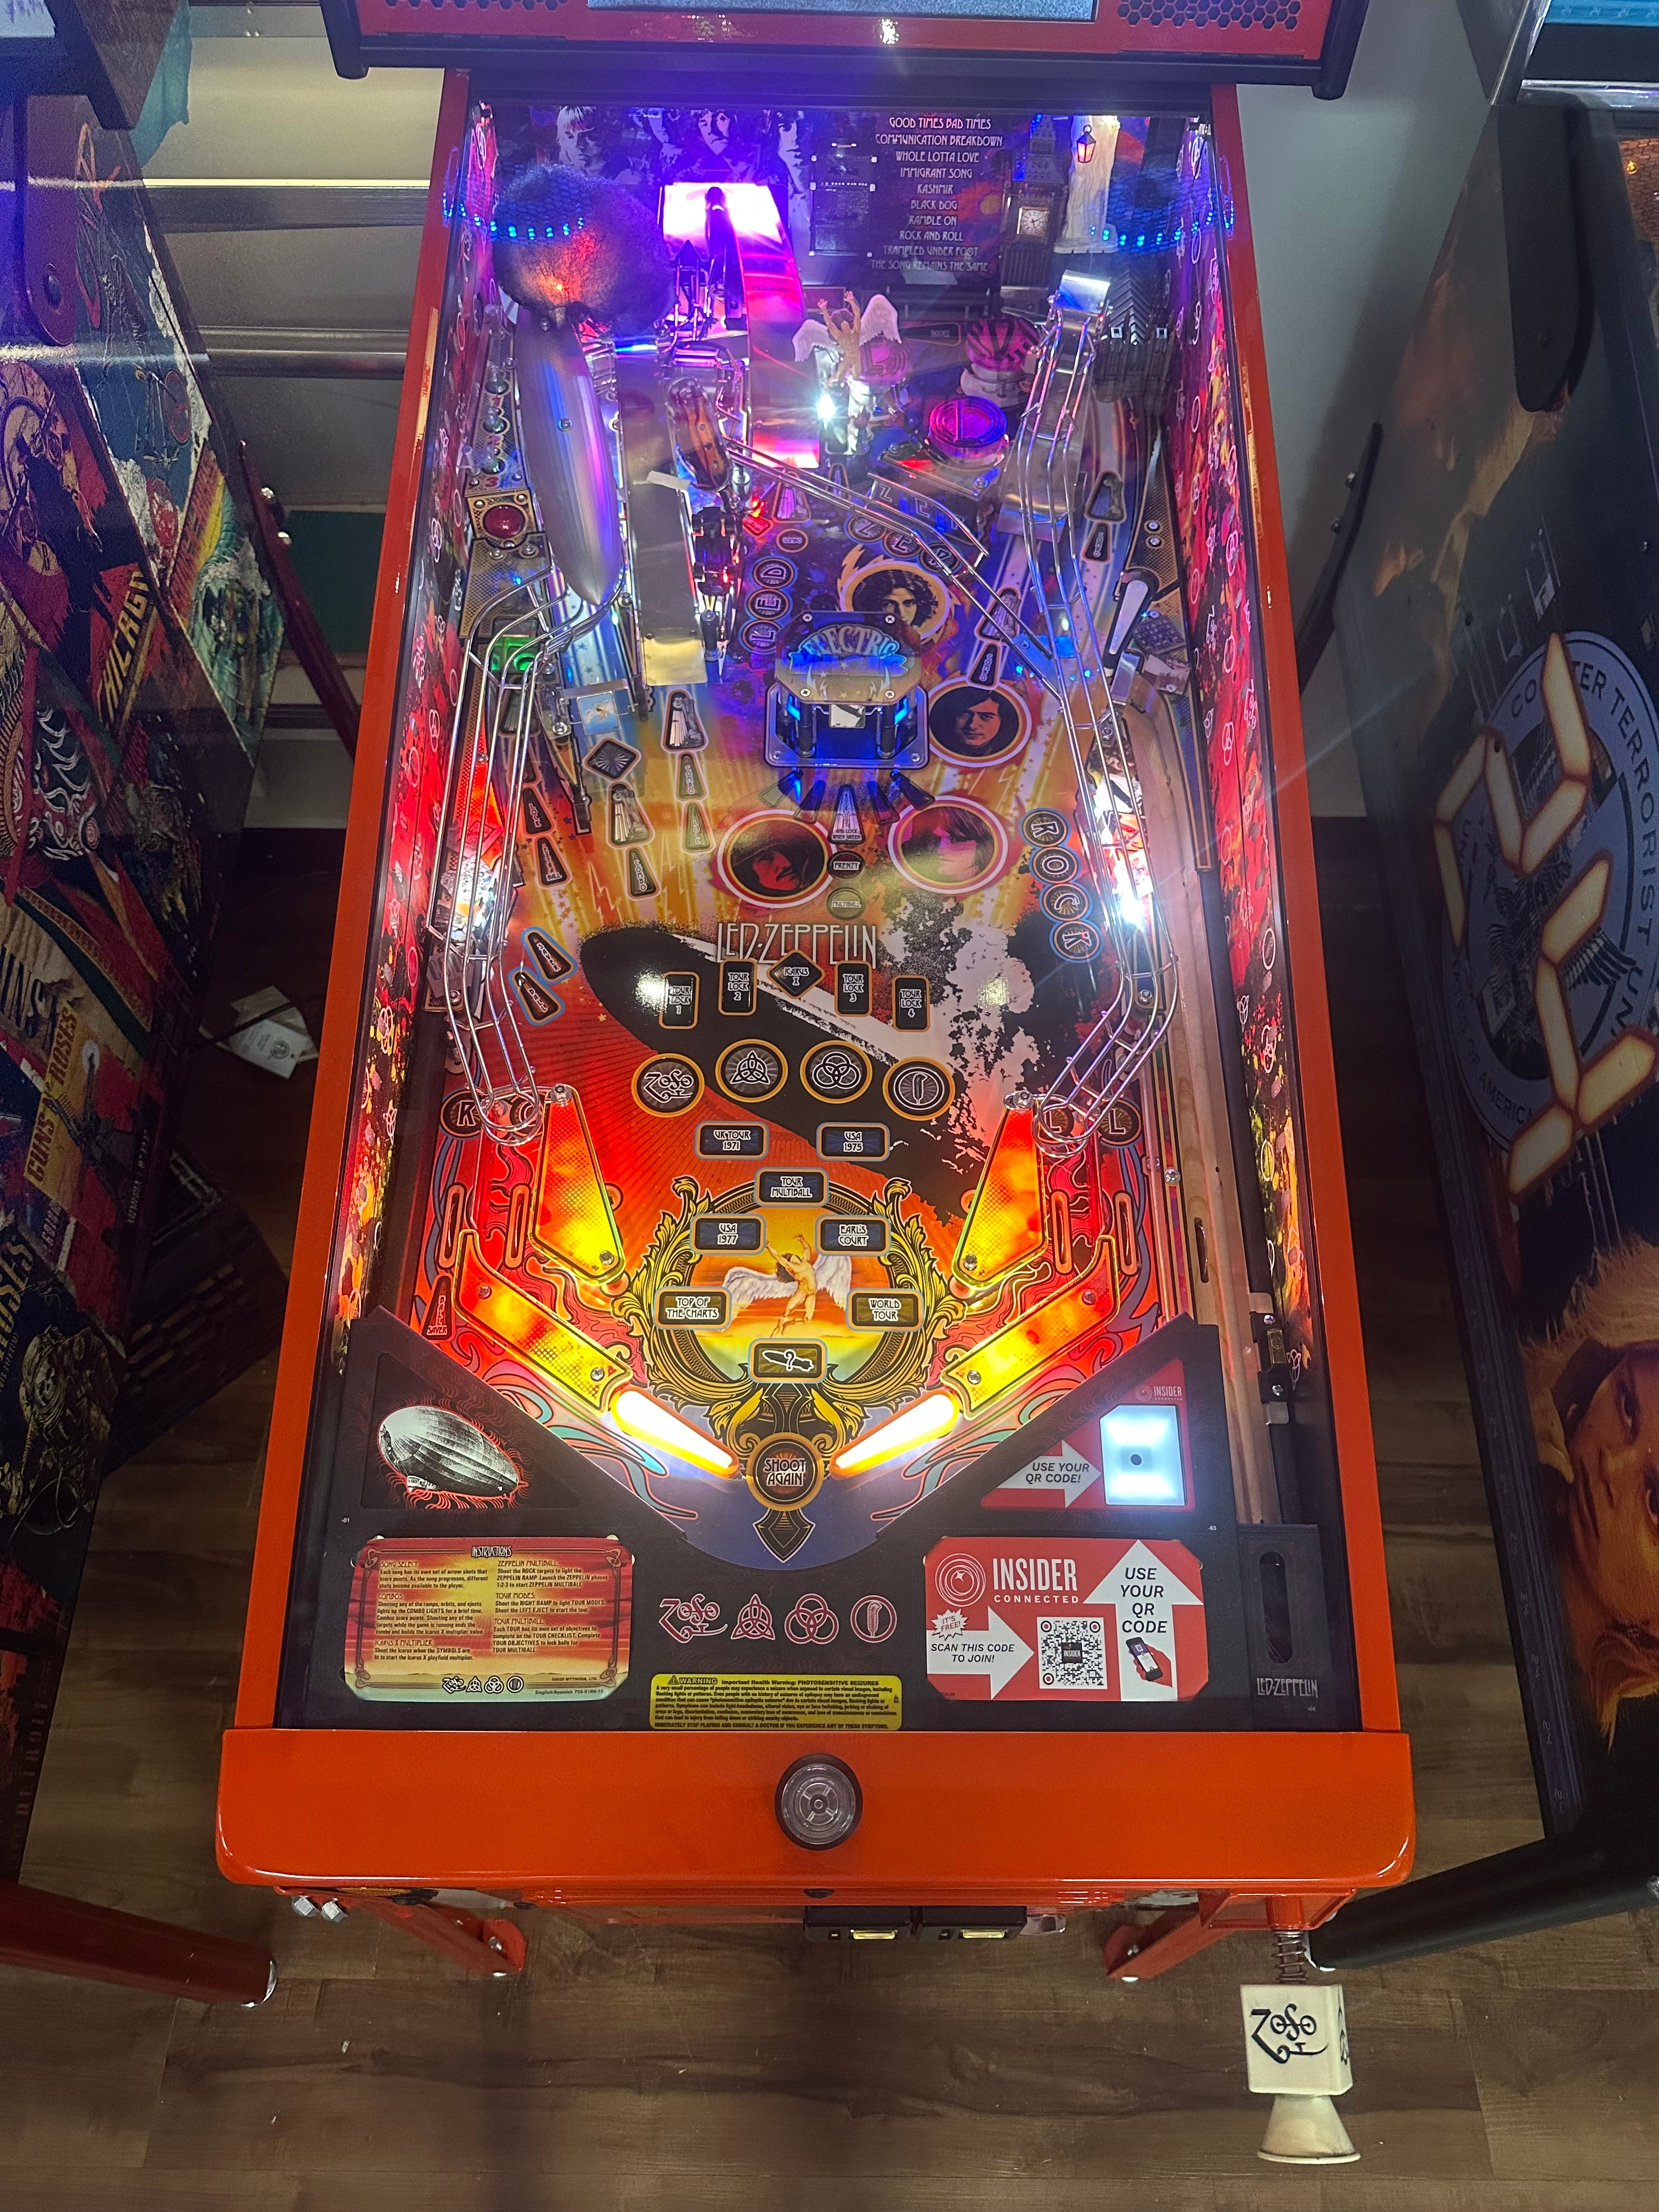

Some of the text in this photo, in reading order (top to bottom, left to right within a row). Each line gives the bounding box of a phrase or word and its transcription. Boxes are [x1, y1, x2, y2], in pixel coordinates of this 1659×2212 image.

[889, 117, 991, 129] GOOD TIMES BAD TIMES
[876, 134, 1003, 146] COMMUNICATION BREAKDOWN
[896, 151, 979, 162] WHOLE LOTTA LOVE
[900, 168, 972, 178] IMMIGRANT SONG
[917, 184, 953, 194] KASHMIR
[911, 200, 957, 210] BLACK DOG
[909, 216, 957, 225] RAMBLE ON
[900, 230, 963, 241] ROCK AND ROLL
[883, 246, 978, 256] TRAMPLED UNDER FOOT
[871, 260, 988, 272] THE SONG REMAINS THE SAME
[833, 861, 860, 870] FRENZY
[728, 972, 749, 981] TOUR
[783, 967, 809, 976] ICARUS
[792, 977, 800, 986] X
[843, 974, 864, 983] TOUR
[670, 985, 691, 995] TOUR
[727, 982, 749, 991] LOCK
[843, 984, 864, 993] LOCK
[734, 992, 742, 1001] 2
[849, 993, 857, 1002] 3
[900, 989, 921, 998] TOUR
[669, 995, 690, 1005] LOCK
[900, 999, 922, 1008] LOCK
[907, 1009, 915, 1018] 4
[714, 1130, 751, 1140] UK TOUR
[844, 1131, 862, 1141] USA
[723, 1141, 741, 1151] 1971
[843, 1142, 863, 1152] 1975
[781, 1176, 803, 1187] TOUR
[771, 1187, 812, 1198] MULTIBALL
[719, 1223, 737, 1233] USA
[839, 1224, 867, 1235] EARL'S
[718, 1234, 738, 1245] 1977
[838, 1235, 869, 1246] COURT
[676, 1296, 710, 1308] TOP OF
[868, 1299, 901, 1310] WORLD
[665, 1307, 719, 1319] THE CHARTS
[873, 1310, 898, 1321] TOUR
[1154, 1386, 1182, 1397] INSIDER
[764, 1458, 806, 1472] SHOOT
[1032, 1463, 1090, 1472] USE YOUR
[766, 1472, 804, 1486] AGAIN
[1026, 1474, 1081, 1484] QR CODE!
[471, 1545, 512, 1558] INSTRUCTIONS
[992, 1558, 1077, 1591] INSIDER
[1125, 1567, 1156, 1580] USE
[1121, 1585, 1164, 1598] YOUR
[994, 1595, 1079, 1604] CONNECTED
[1132, 1602, 1154, 1618] QR
[943, 1616, 956, 1624] IT'S
[941, 1621, 961, 1632] FREE!
[1122, 1620, 1167, 1633] CODE
[930, 1644, 1014, 1652] SCAN THIS CODE
[968, 1655, 995, 1663] JOIN!
